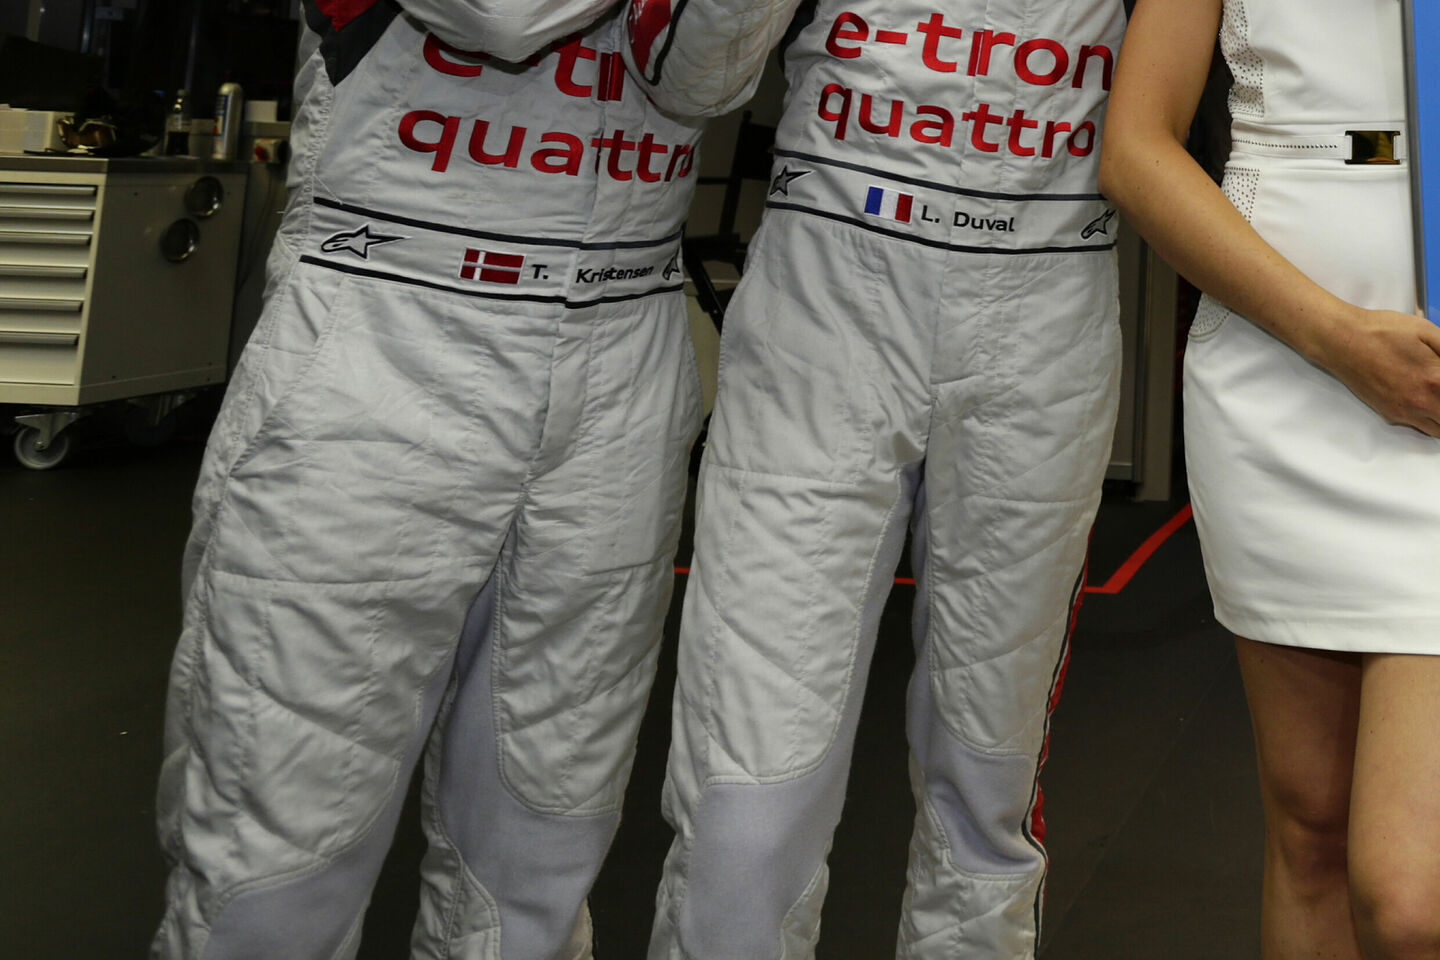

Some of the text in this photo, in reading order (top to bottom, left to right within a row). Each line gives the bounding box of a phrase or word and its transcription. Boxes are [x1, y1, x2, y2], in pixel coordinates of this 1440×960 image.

[824, 11, 1113, 91] e-tron
[817, 82, 1096, 159] quattro
[920, 203, 1015, 233] L. Duval
[530, 263, 655, 284] T. Kristensen
